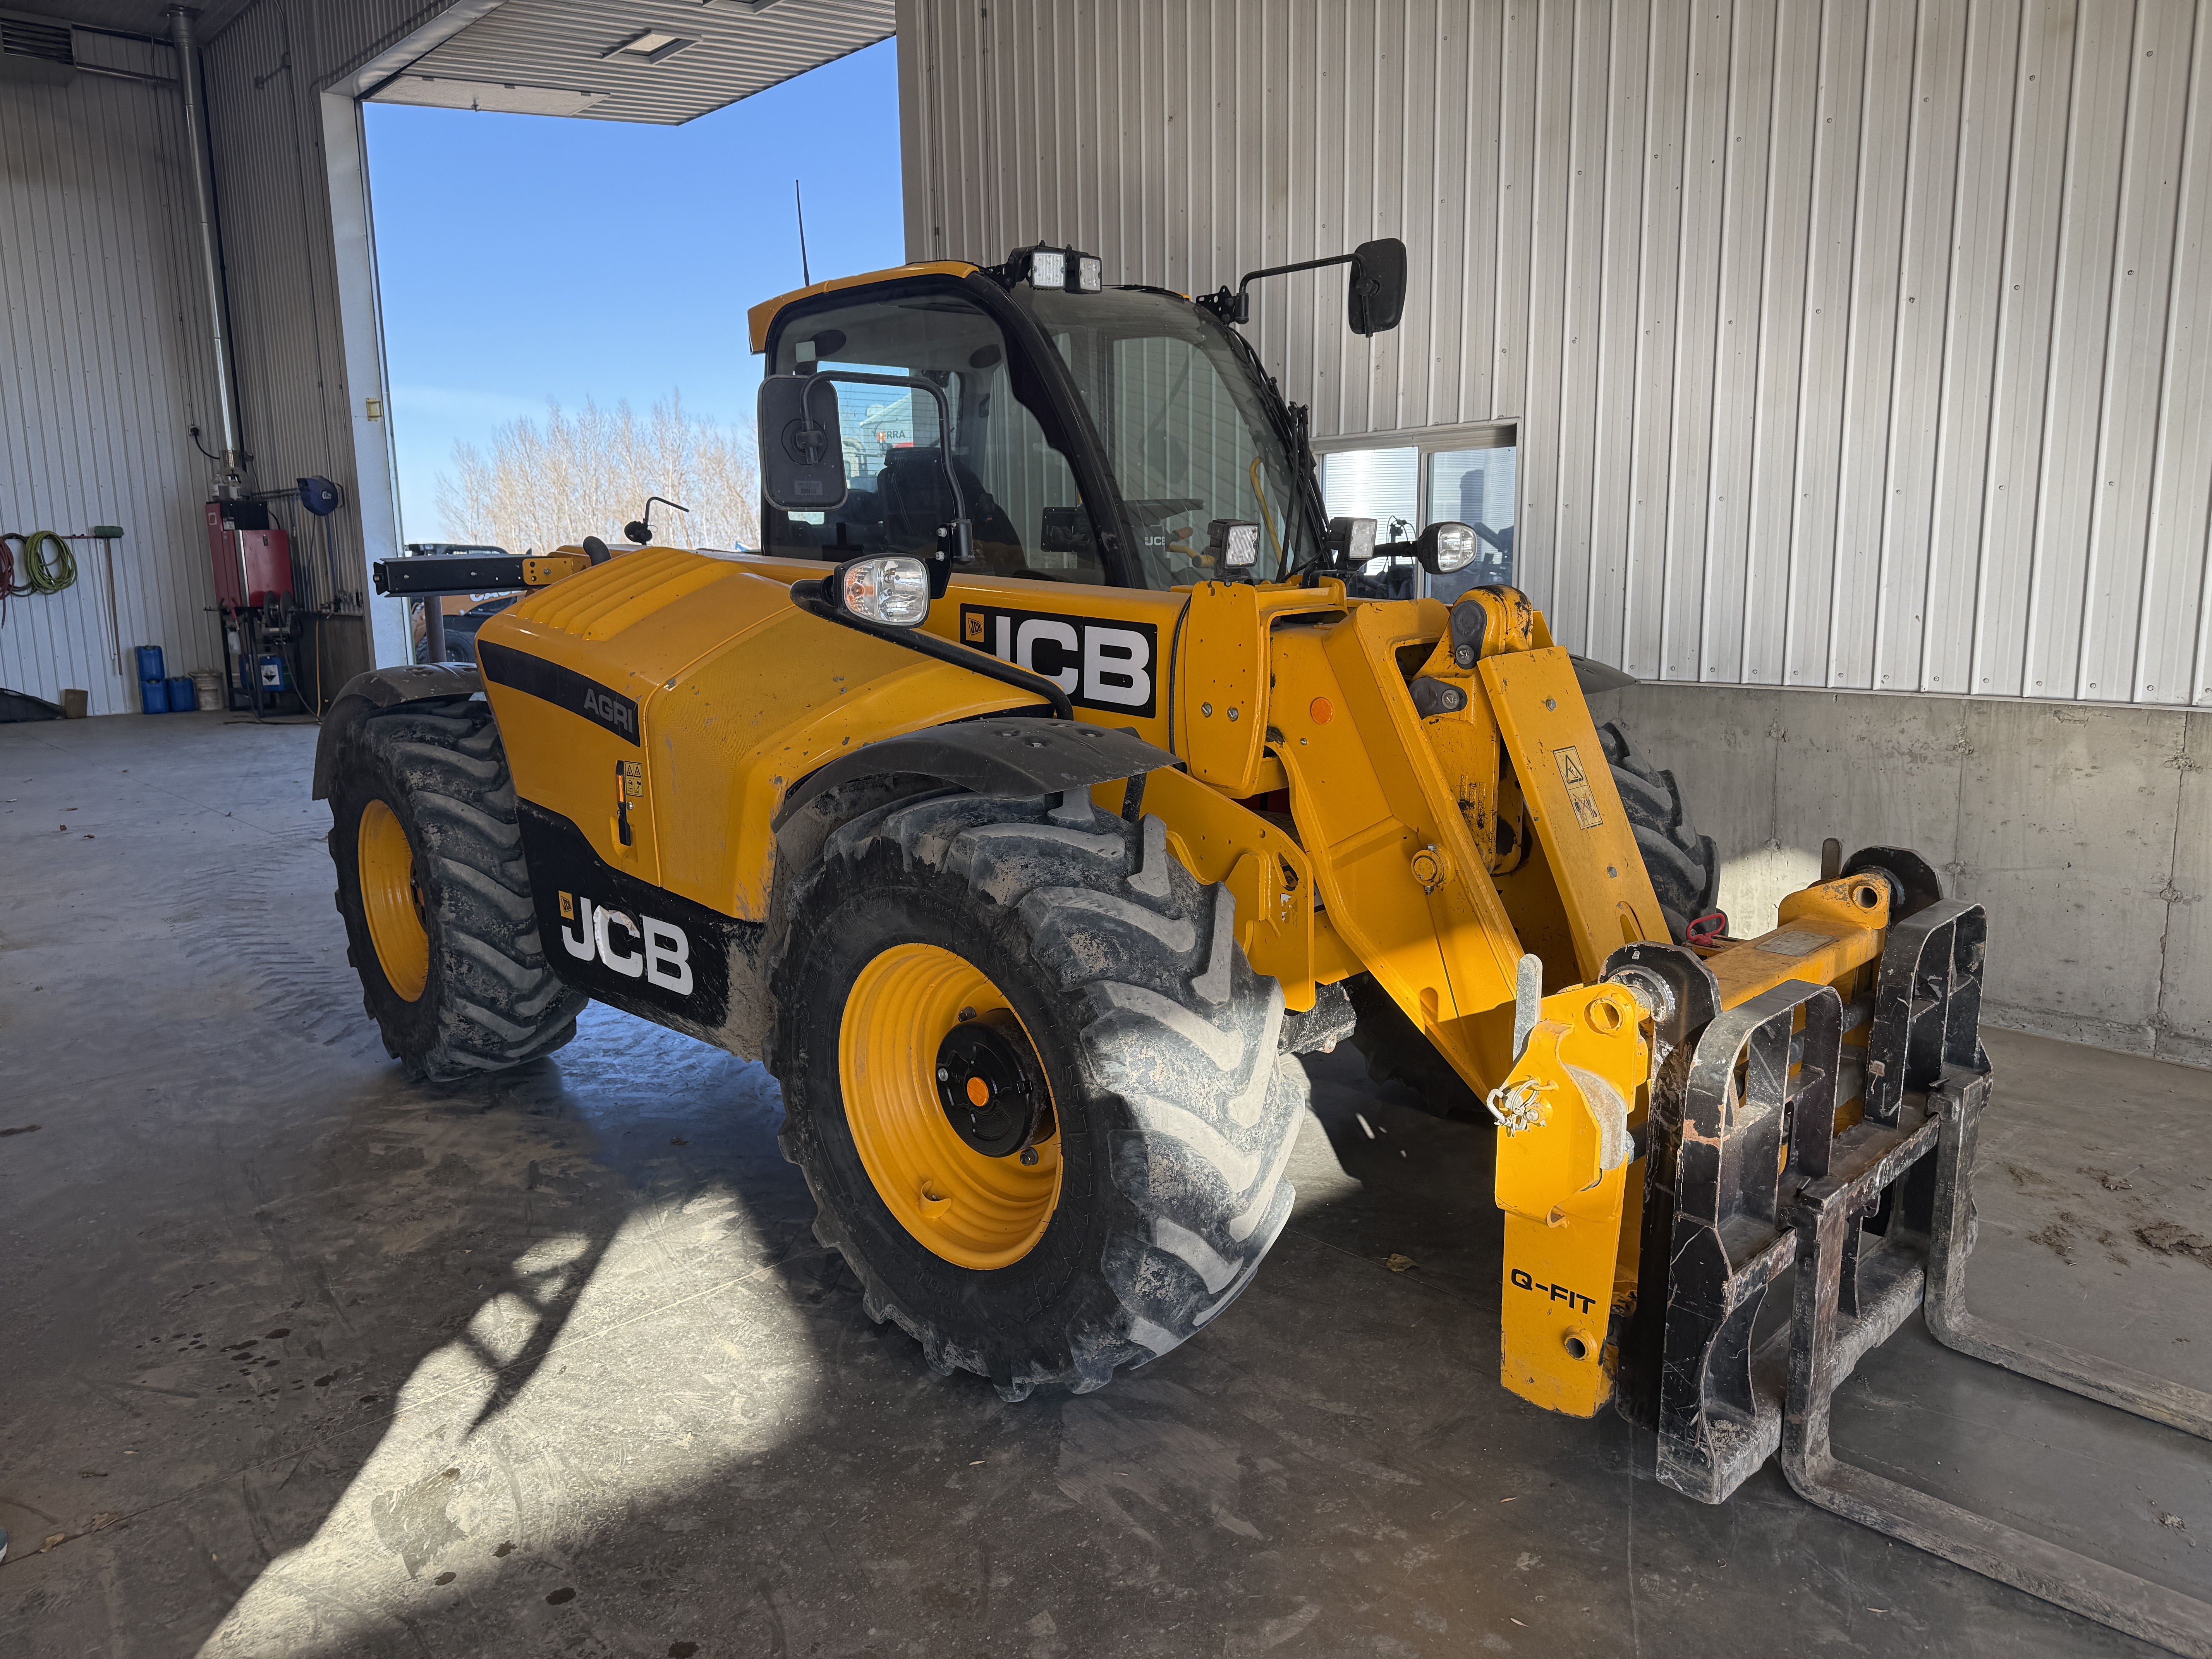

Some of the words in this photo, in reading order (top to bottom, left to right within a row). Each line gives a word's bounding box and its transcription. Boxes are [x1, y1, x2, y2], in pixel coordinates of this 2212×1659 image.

[970, 620, 981, 634] JCB
[584, 688, 633, 734] AGRI
[863, 894, 891, 918] 580
[562, 896, 694, 996] JCB
[802, 909, 857, 1007] INDUSTRIAL
[798, 1003, 810, 1067] AGRO
[1511, 1268, 1596, 1315] Q-FIT
